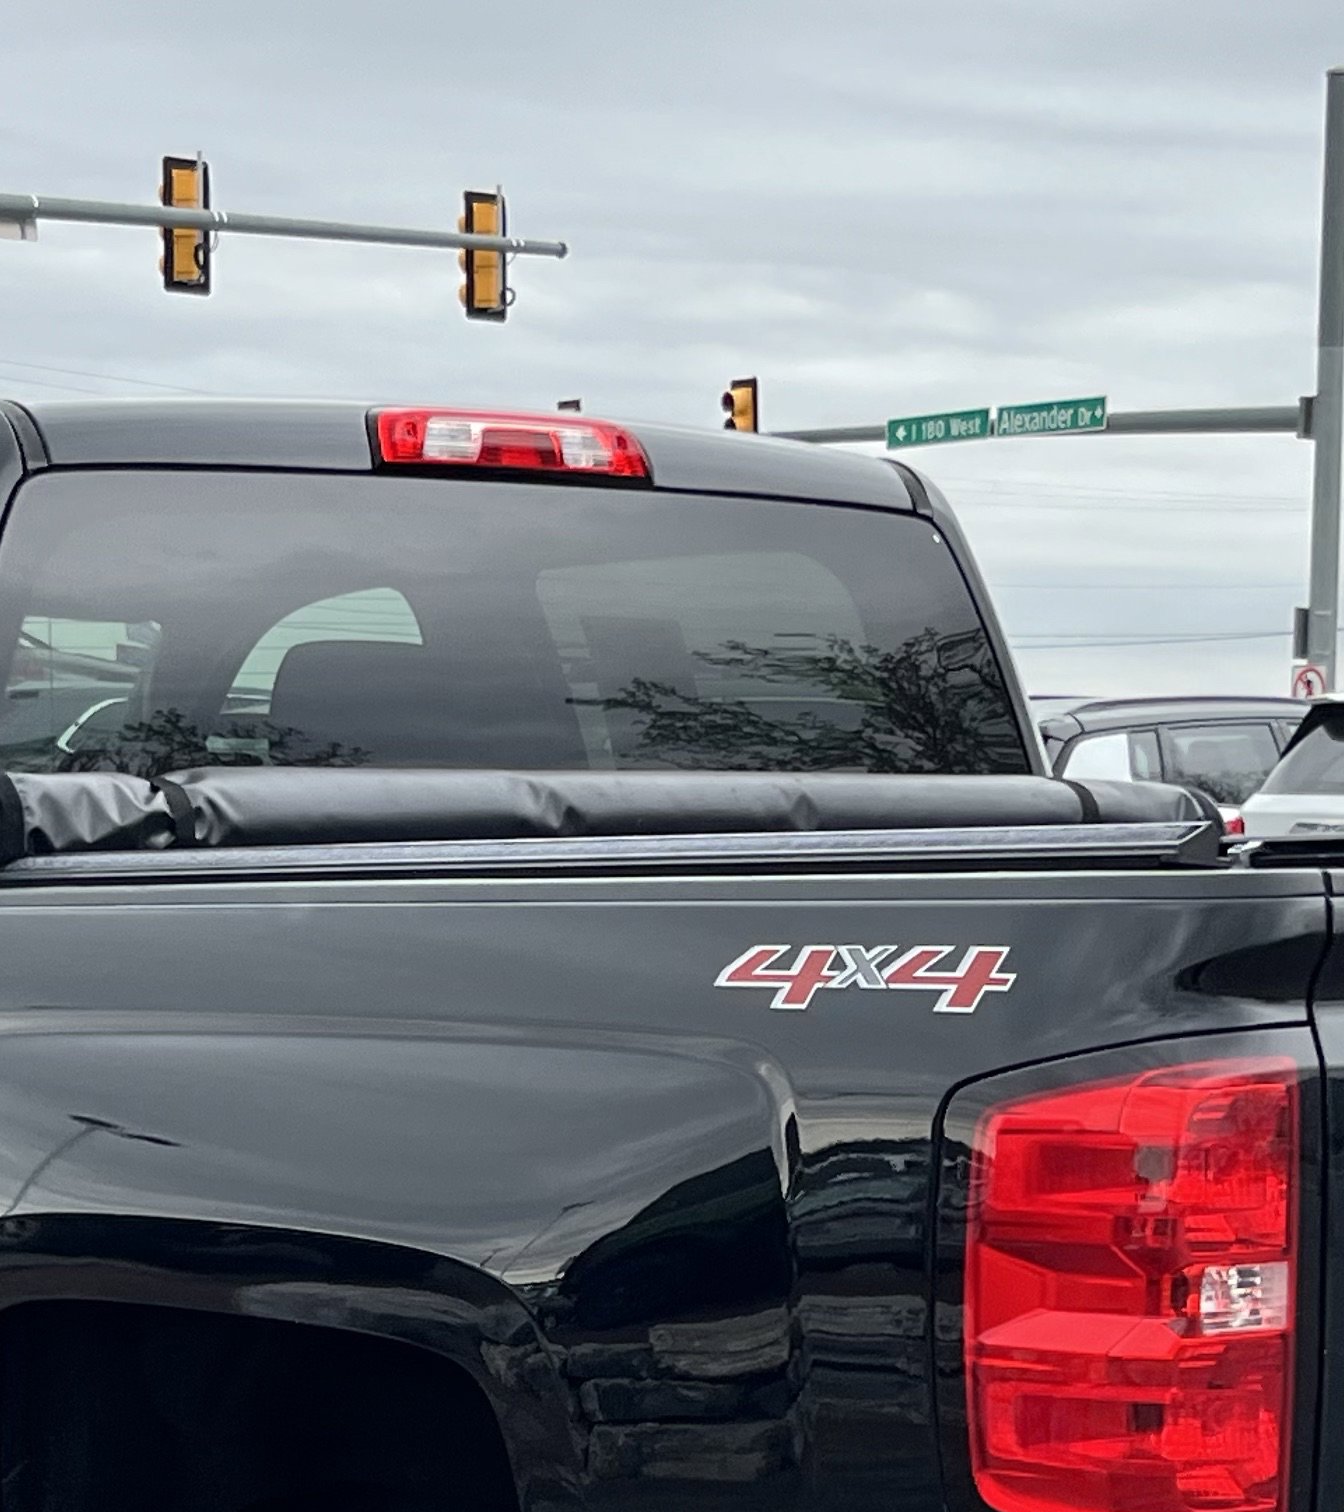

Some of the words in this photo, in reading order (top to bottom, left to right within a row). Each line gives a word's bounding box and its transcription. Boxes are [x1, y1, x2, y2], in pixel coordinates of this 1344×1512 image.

[921, 420, 945, 439] 180
[950, 417, 981, 435] West
[998, 405, 1074, 434] Alexander
[1077, 408, 1092, 425] Dr
